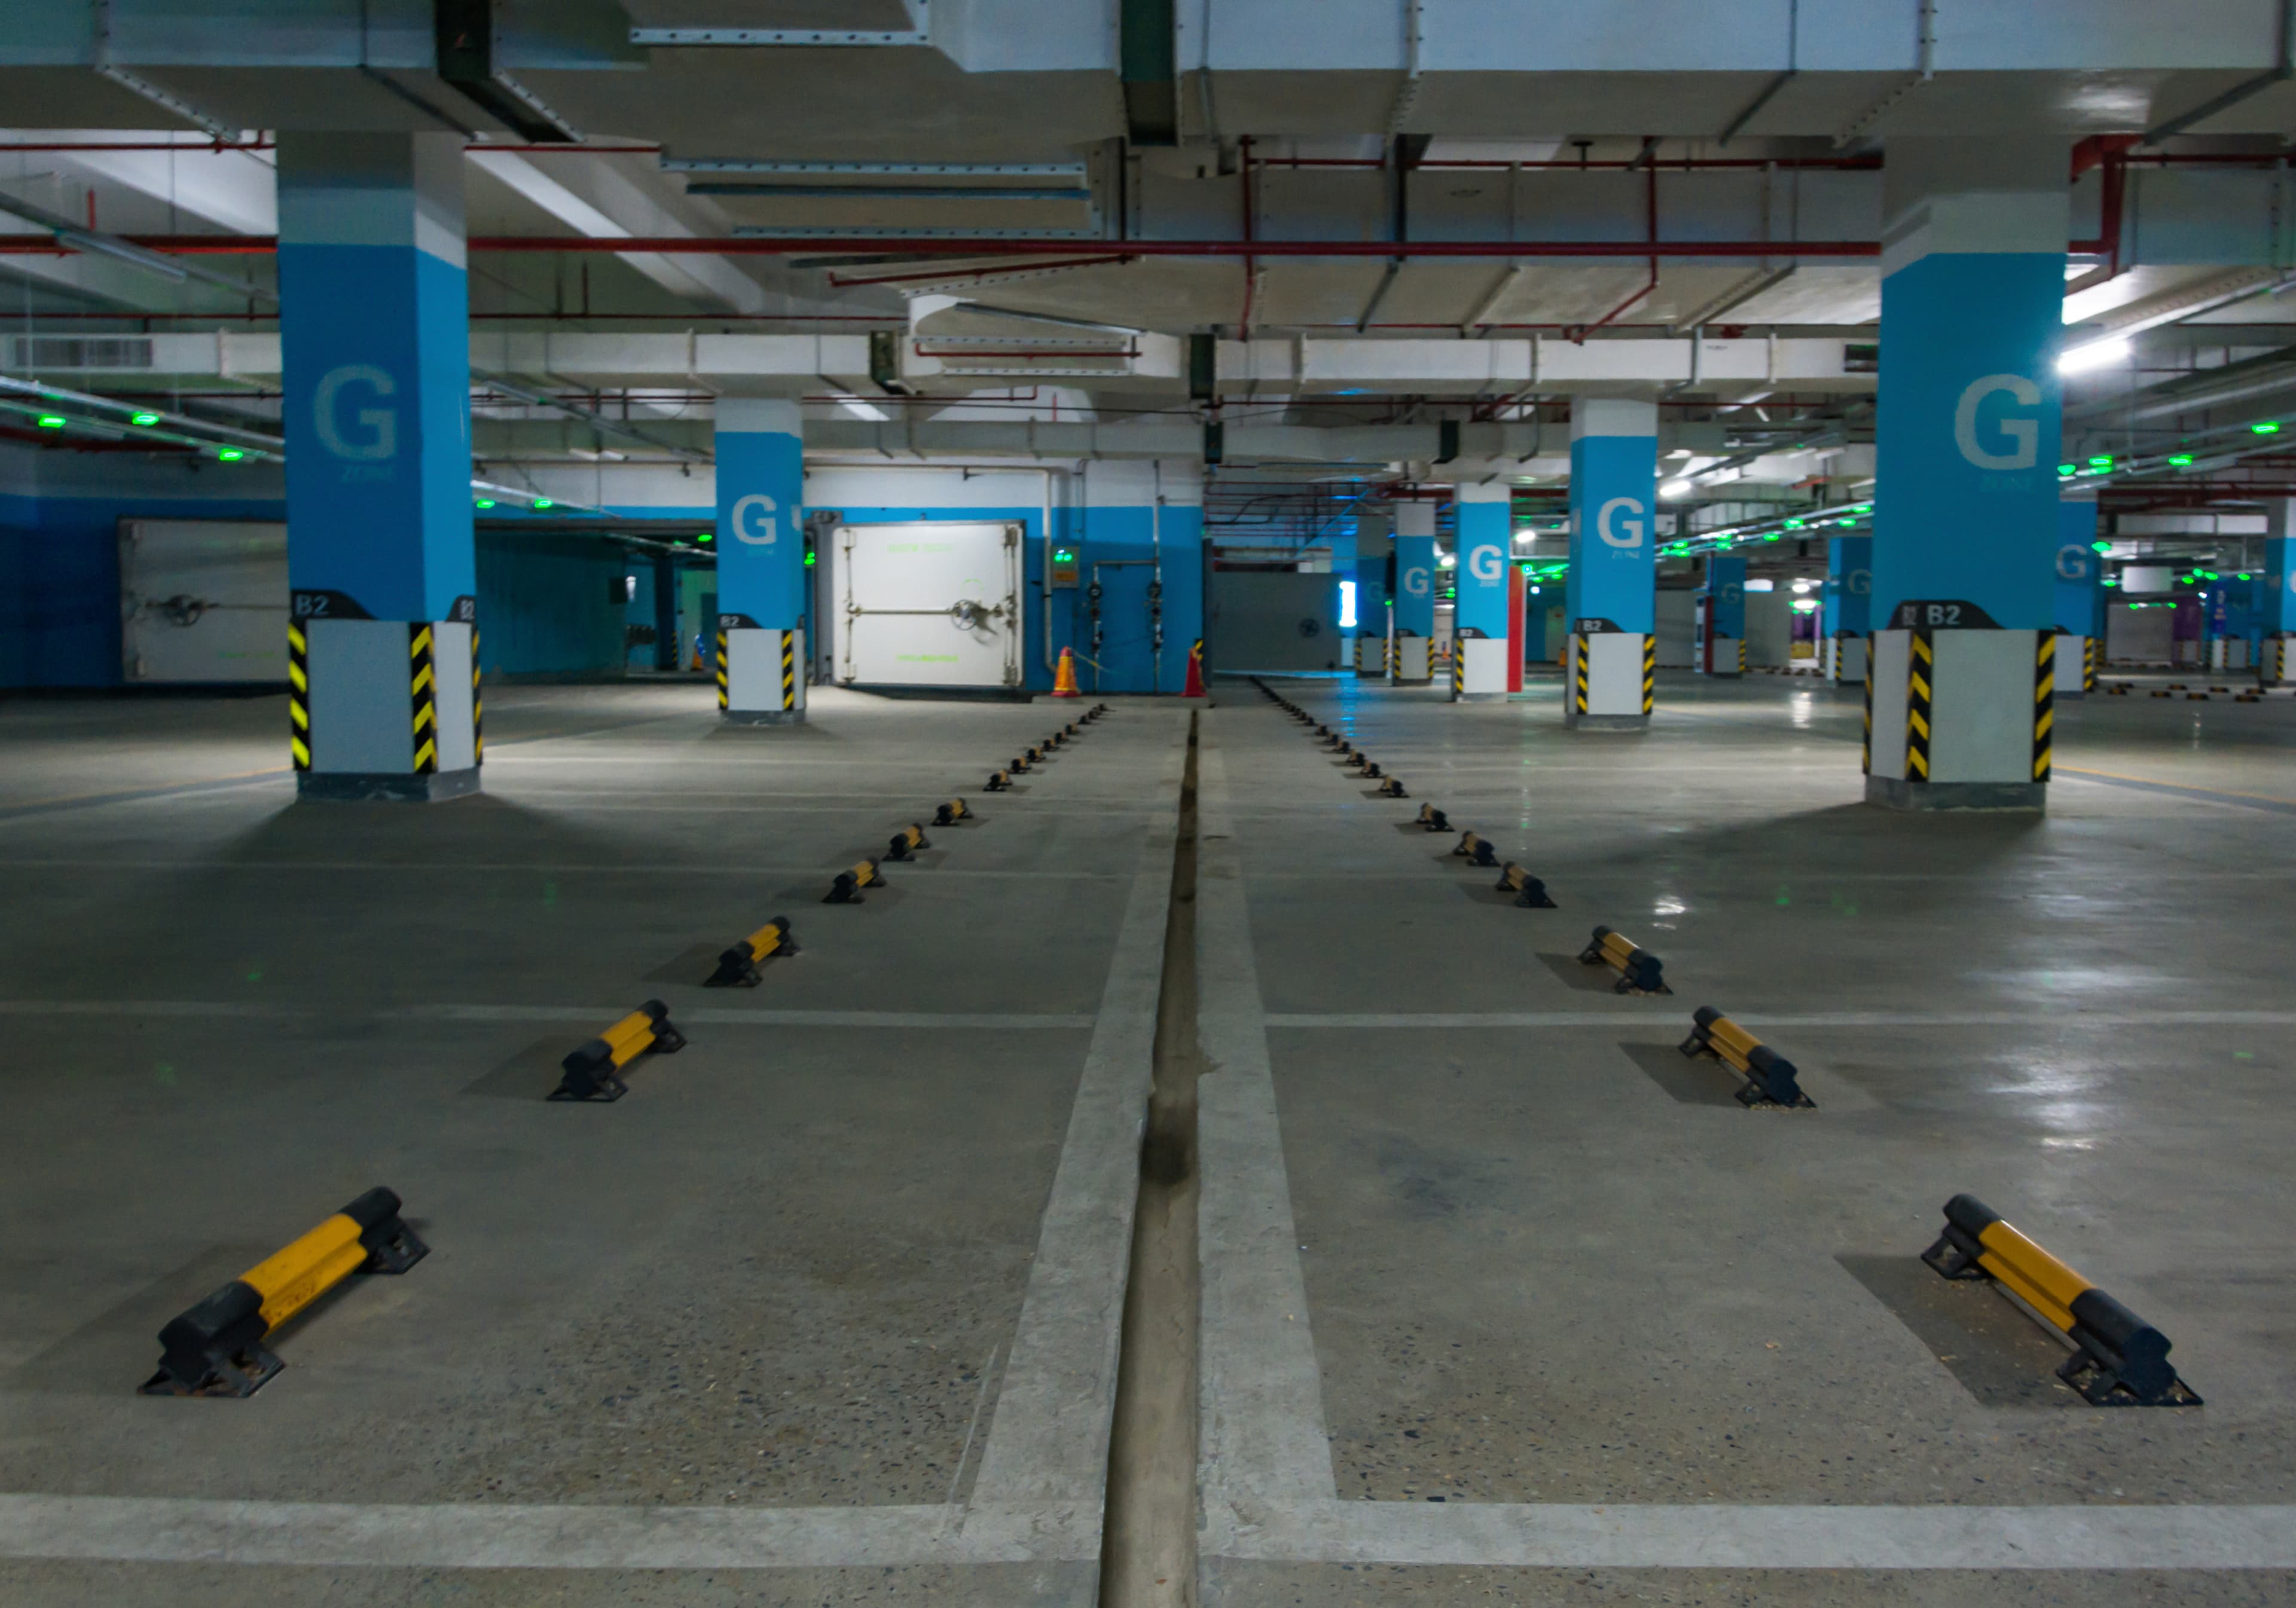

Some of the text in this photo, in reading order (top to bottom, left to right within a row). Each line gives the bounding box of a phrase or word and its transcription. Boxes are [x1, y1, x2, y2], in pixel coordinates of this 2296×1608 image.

[312, 363, 398, 460] G
[1954, 374, 2041, 470] G
[732, 494, 777, 545] G
[1596, 497, 1644, 548] G
[1469, 544, 1503, 580] G
[2056, 544, 2087, 579] G
[1404, 567, 1429, 594] G
[1848, 568, 1873, 594] G
[295, 594, 329, 616] B2
[1927, 604, 1962, 626] B2
[720, 615, 740, 627] B2
[1583, 620, 1602, 631] B2
